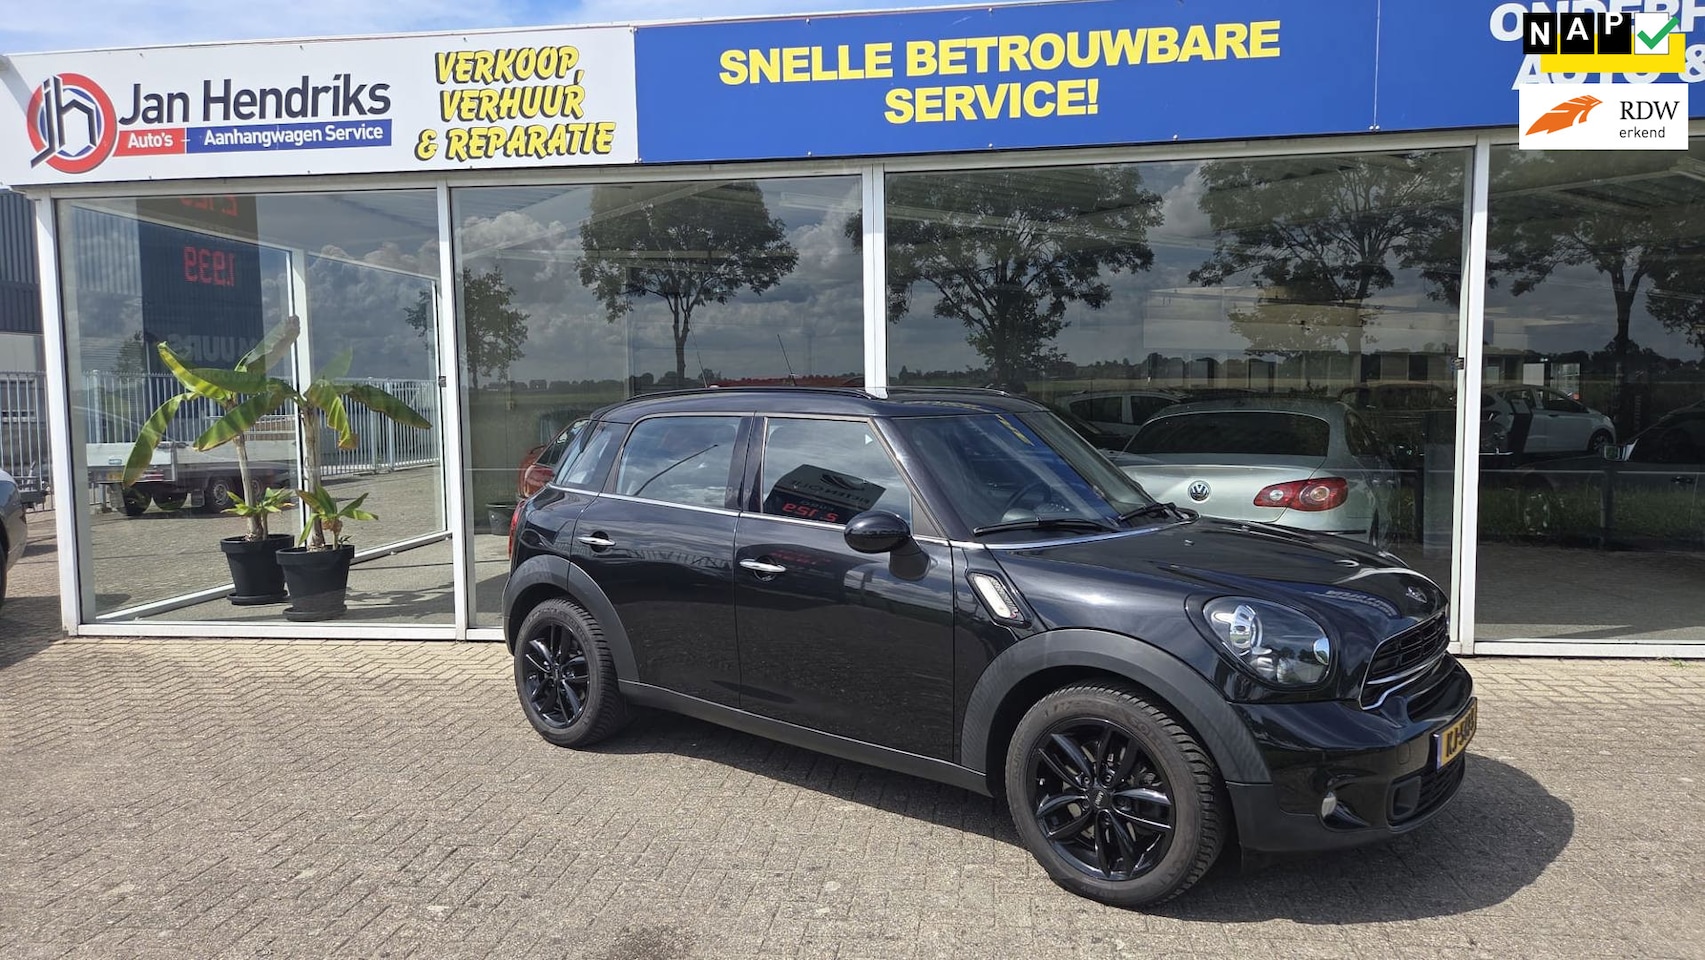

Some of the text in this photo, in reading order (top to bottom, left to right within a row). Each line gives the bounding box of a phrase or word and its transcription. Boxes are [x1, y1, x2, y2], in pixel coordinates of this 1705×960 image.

[434, 45, 585, 84] VERKOOP,
[718, 20, 1281, 86] SNELLE BETROUWBARE
[118, 73, 391, 126] Jan Hendriks
[440, 84, 586, 123] VERHUUR
[884, 78, 1099, 124] SERVICE!
[127, 132, 174, 149] Auto's
[203, 123, 383, 148] Aanhangwagen Service
[414, 121, 617, 163] & REPARATIE
